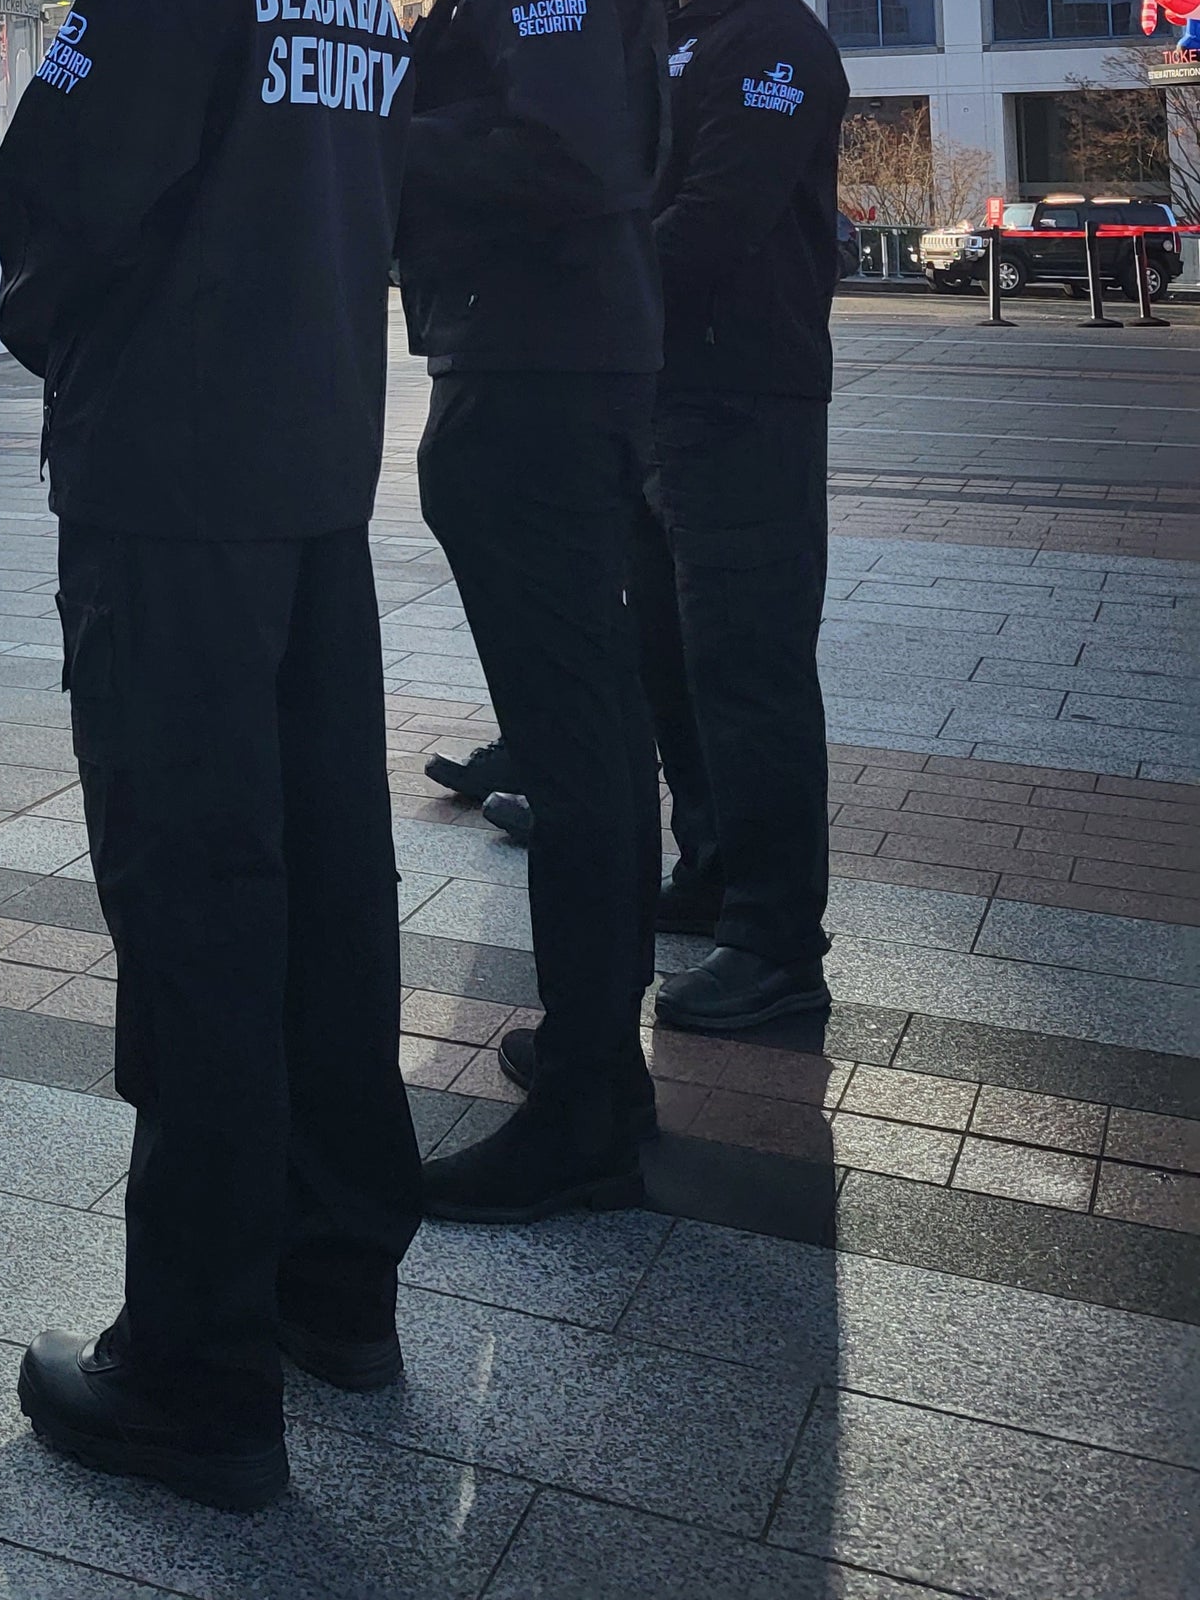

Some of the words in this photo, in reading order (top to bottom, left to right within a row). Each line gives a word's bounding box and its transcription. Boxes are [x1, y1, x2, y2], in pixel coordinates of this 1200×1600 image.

[519, 15, 583, 37] SECURITY
[1162, 48, 1200, 65] TICKE
[742, 77, 804, 104] BLACKBIRD
[743, 92, 797, 116] SECURITY
